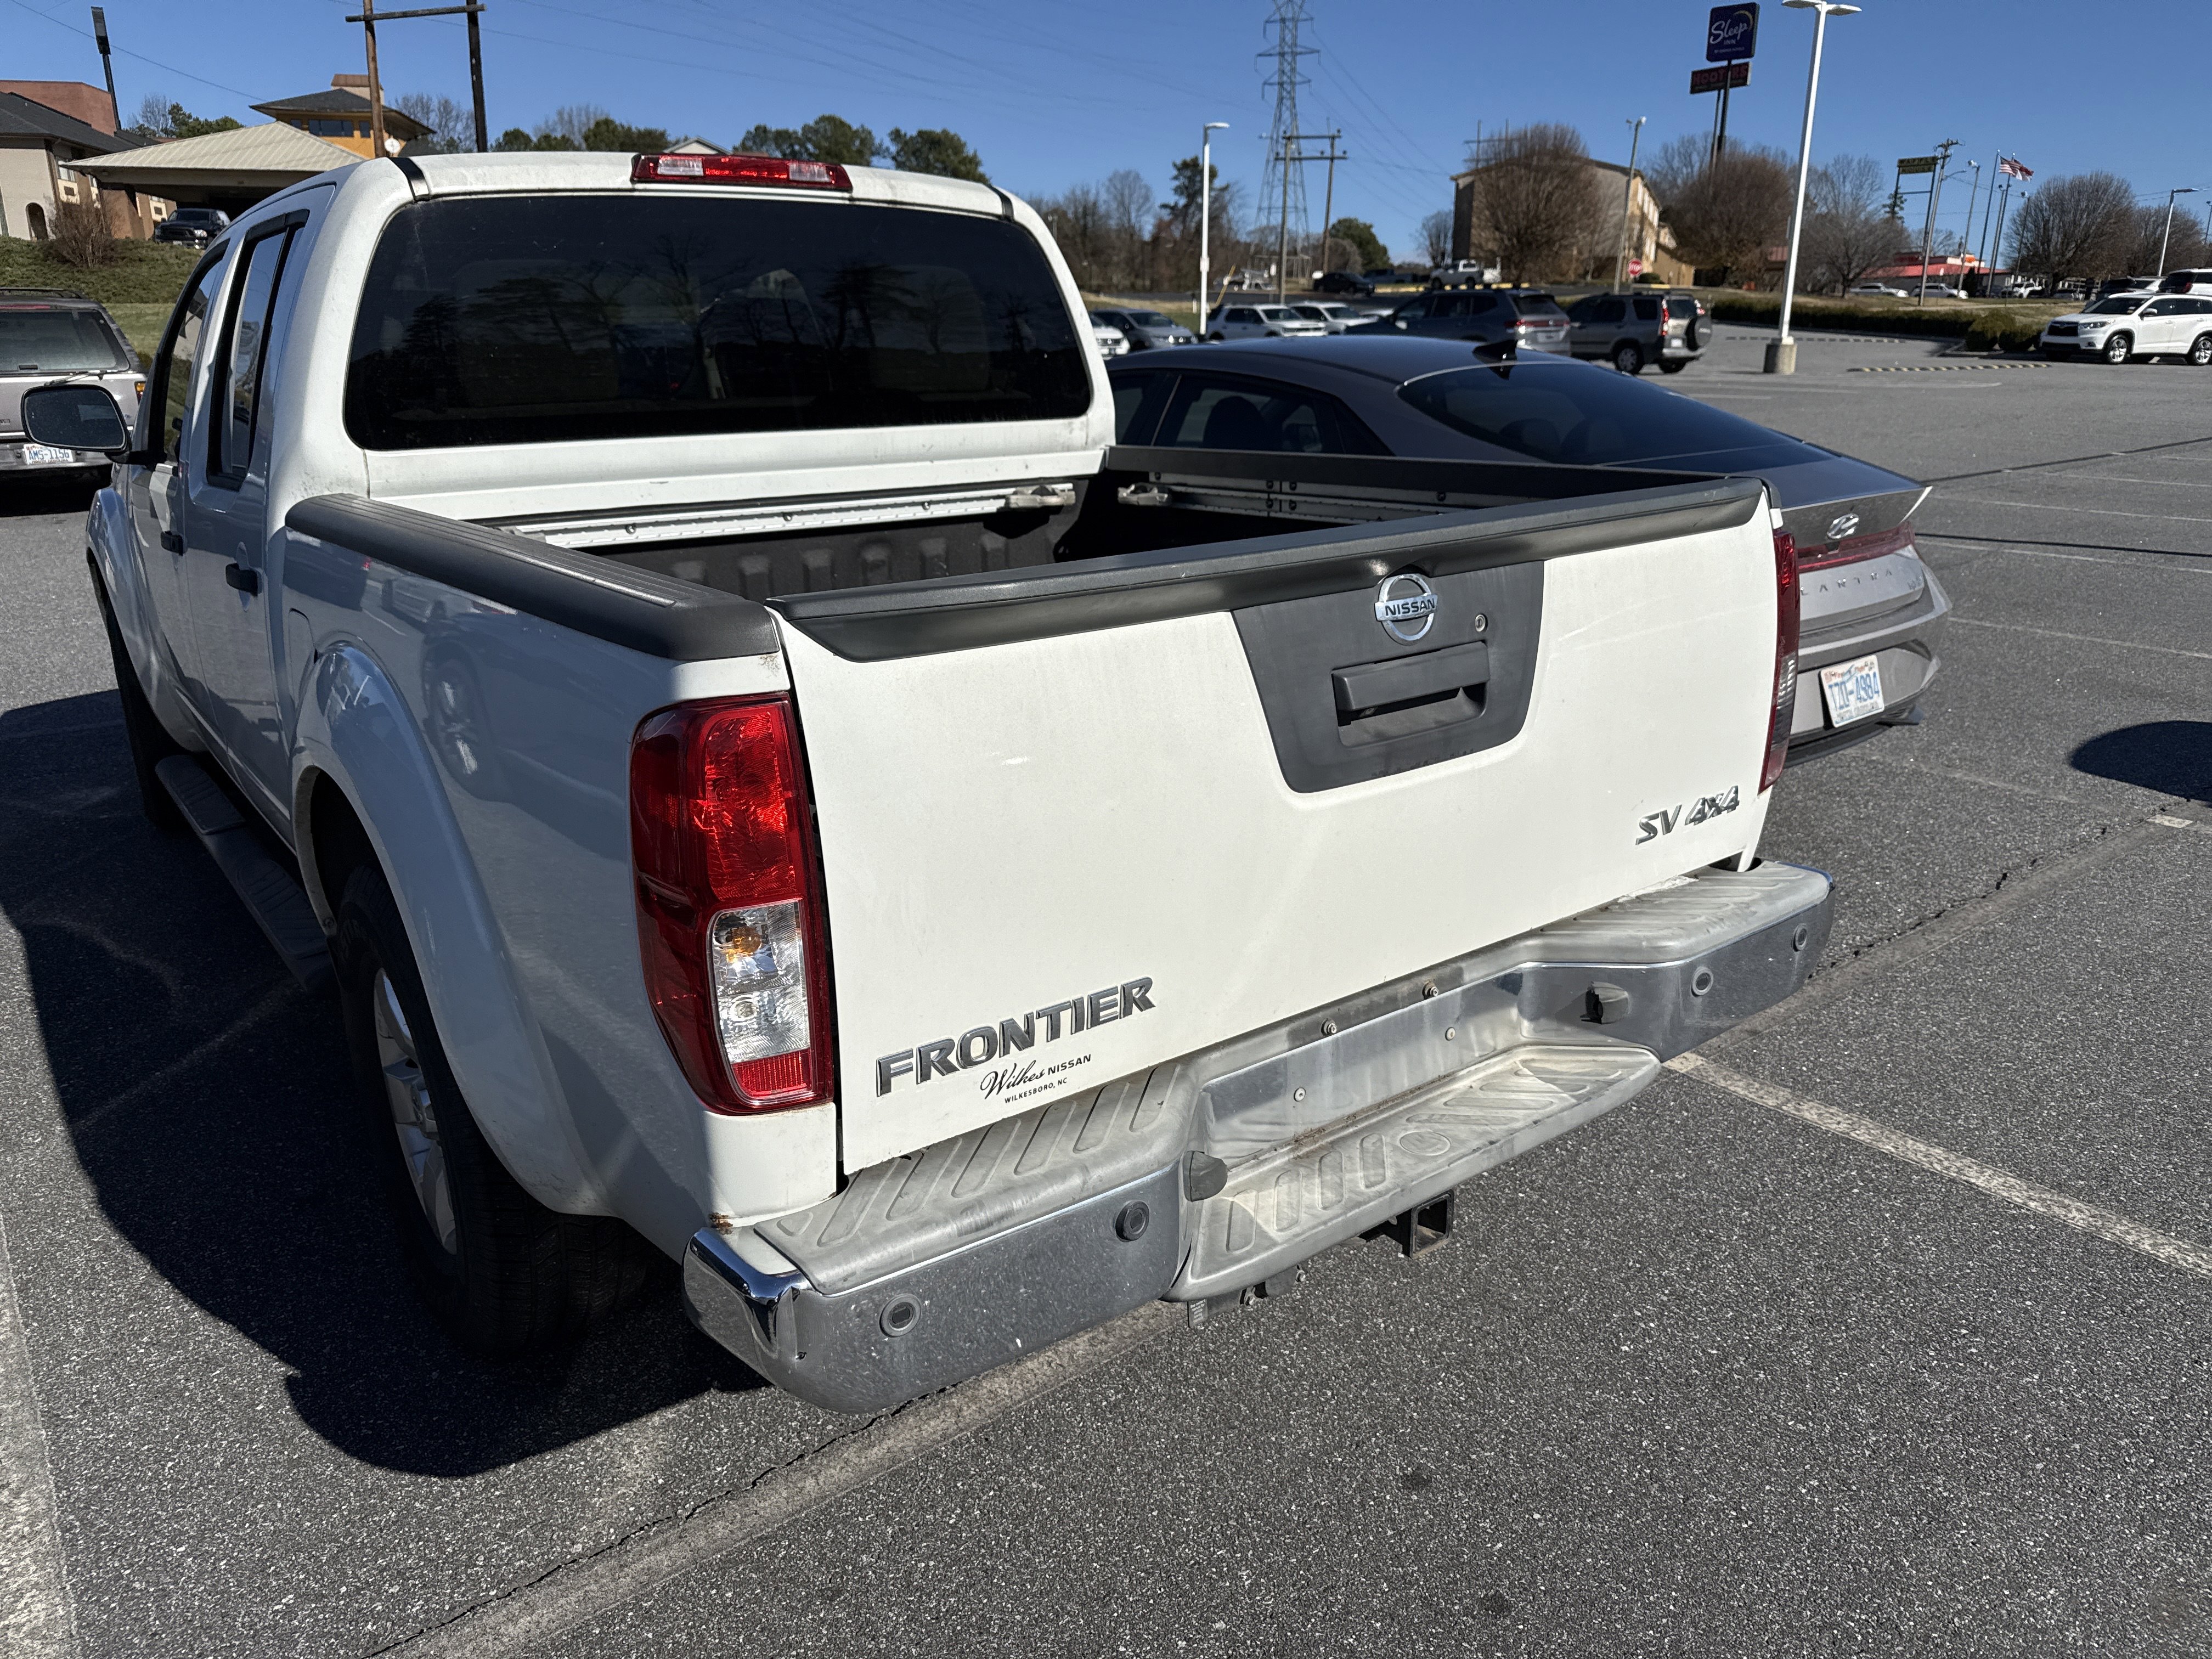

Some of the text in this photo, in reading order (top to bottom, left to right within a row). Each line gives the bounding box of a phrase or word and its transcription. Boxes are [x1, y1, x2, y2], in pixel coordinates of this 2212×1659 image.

[1709, 19, 1748, 44] Sleep
[1693, 64, 1747, 84] HOOTRS
[1800, 568, 1892, 596] LANTRA
[1385, 598, 1436, 616] NISSAN
[1635, 804, 1683, 845] SV
[876, 976, 1156, 1097] FRONTIER
[980, 1054, 1091, 1100] Wilkes NISSAN
[1005, 1077, 1068, 1104] WILKESBORO, NC
